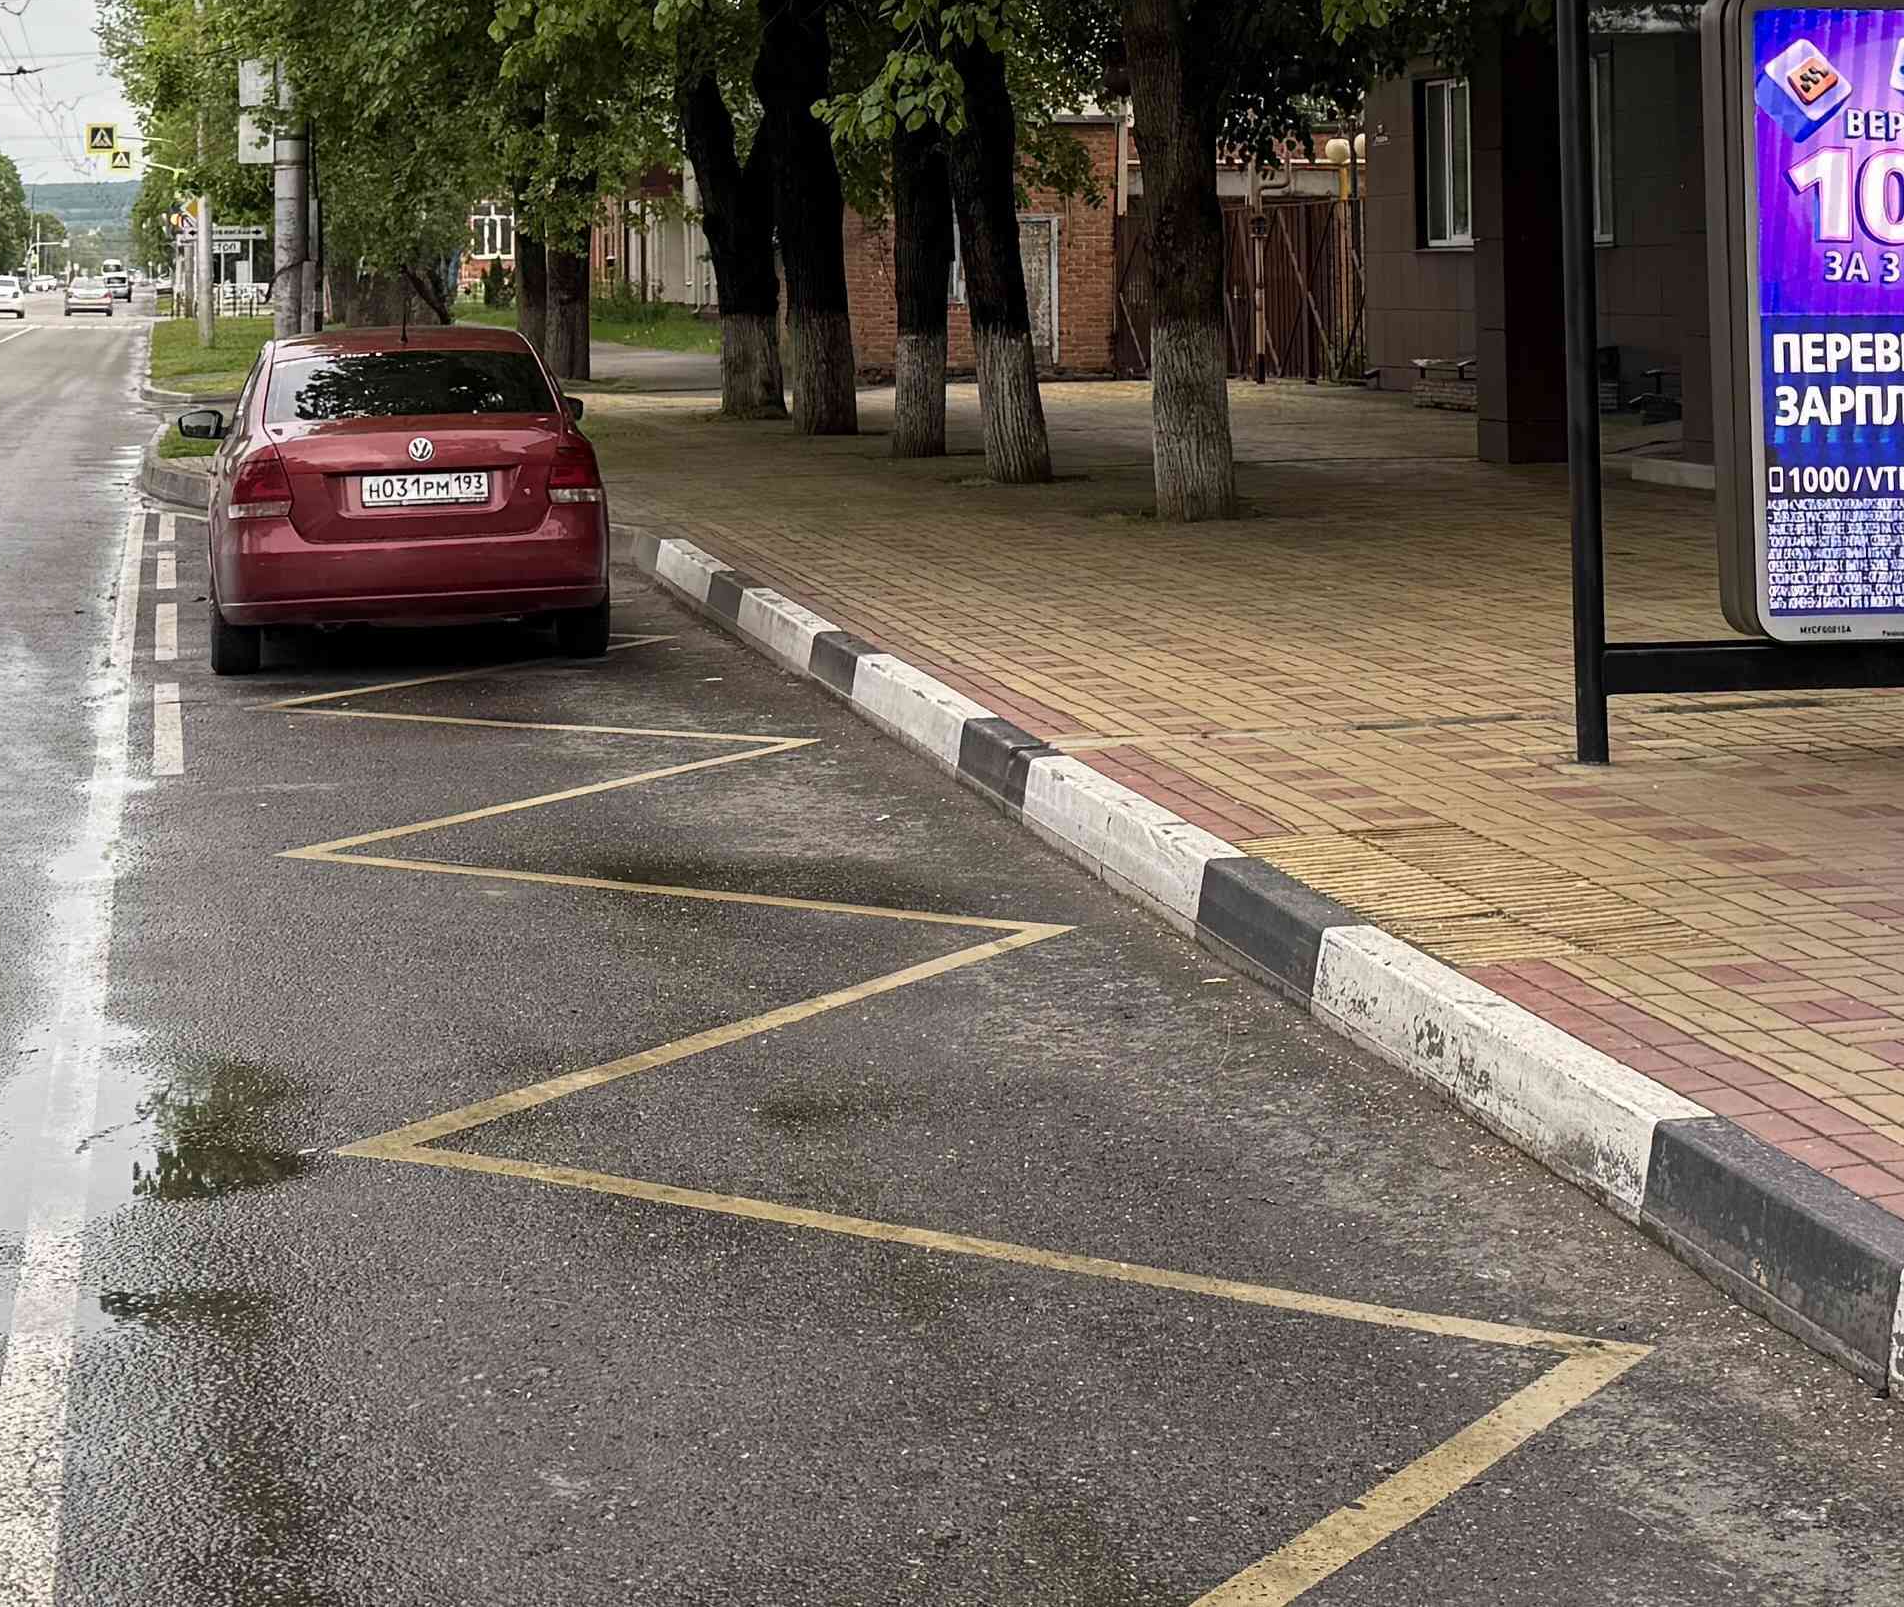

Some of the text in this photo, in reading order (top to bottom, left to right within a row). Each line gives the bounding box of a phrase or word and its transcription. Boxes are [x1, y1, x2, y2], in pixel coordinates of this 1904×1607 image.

[1824, 251, 1871, 282] ЗА
[1880, 252, 1902, 283] 3
[454, 474, 484, 490] 193
